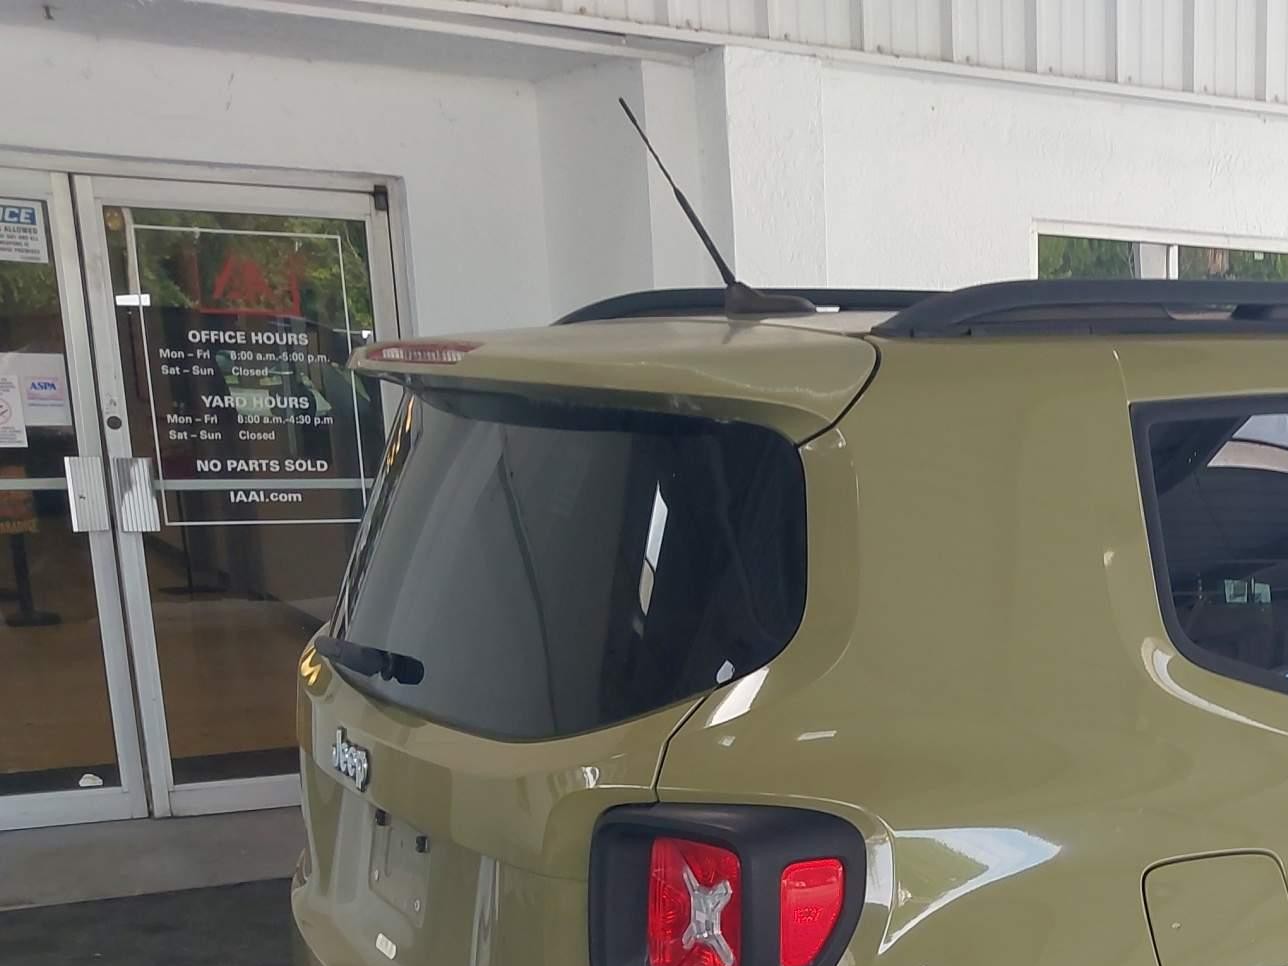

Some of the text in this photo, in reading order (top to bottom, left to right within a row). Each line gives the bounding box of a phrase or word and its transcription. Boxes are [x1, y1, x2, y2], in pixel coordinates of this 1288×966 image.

[188, 330, 309, 346] OFFICE HOURS
[159, 349, 185, 359] Mon
[197, 350, 210, 360] Fri
[308, 353, 330, 364] p.m.
[161, 365, 180, 375] Sat
[192, 366, 214, 376] Sun
[232, 367, 268, 377] Closed
[30, 382, 57, 391] ASPA
[202, 395, 310, 409] YARD HOURS
[167, 414, 193, 424] Mon
[204, 414, 218, 424] Fri
[169, 430, 188, 440] Sat
[200, 430, 222, 440] Sun
[239, 430, 275, 441] Closed
[196, 460, 328, 472] NO PARTS SOLD
[230, 490, 302, 503] IAAI.com
[332, 728, 368, 792] Jeep
